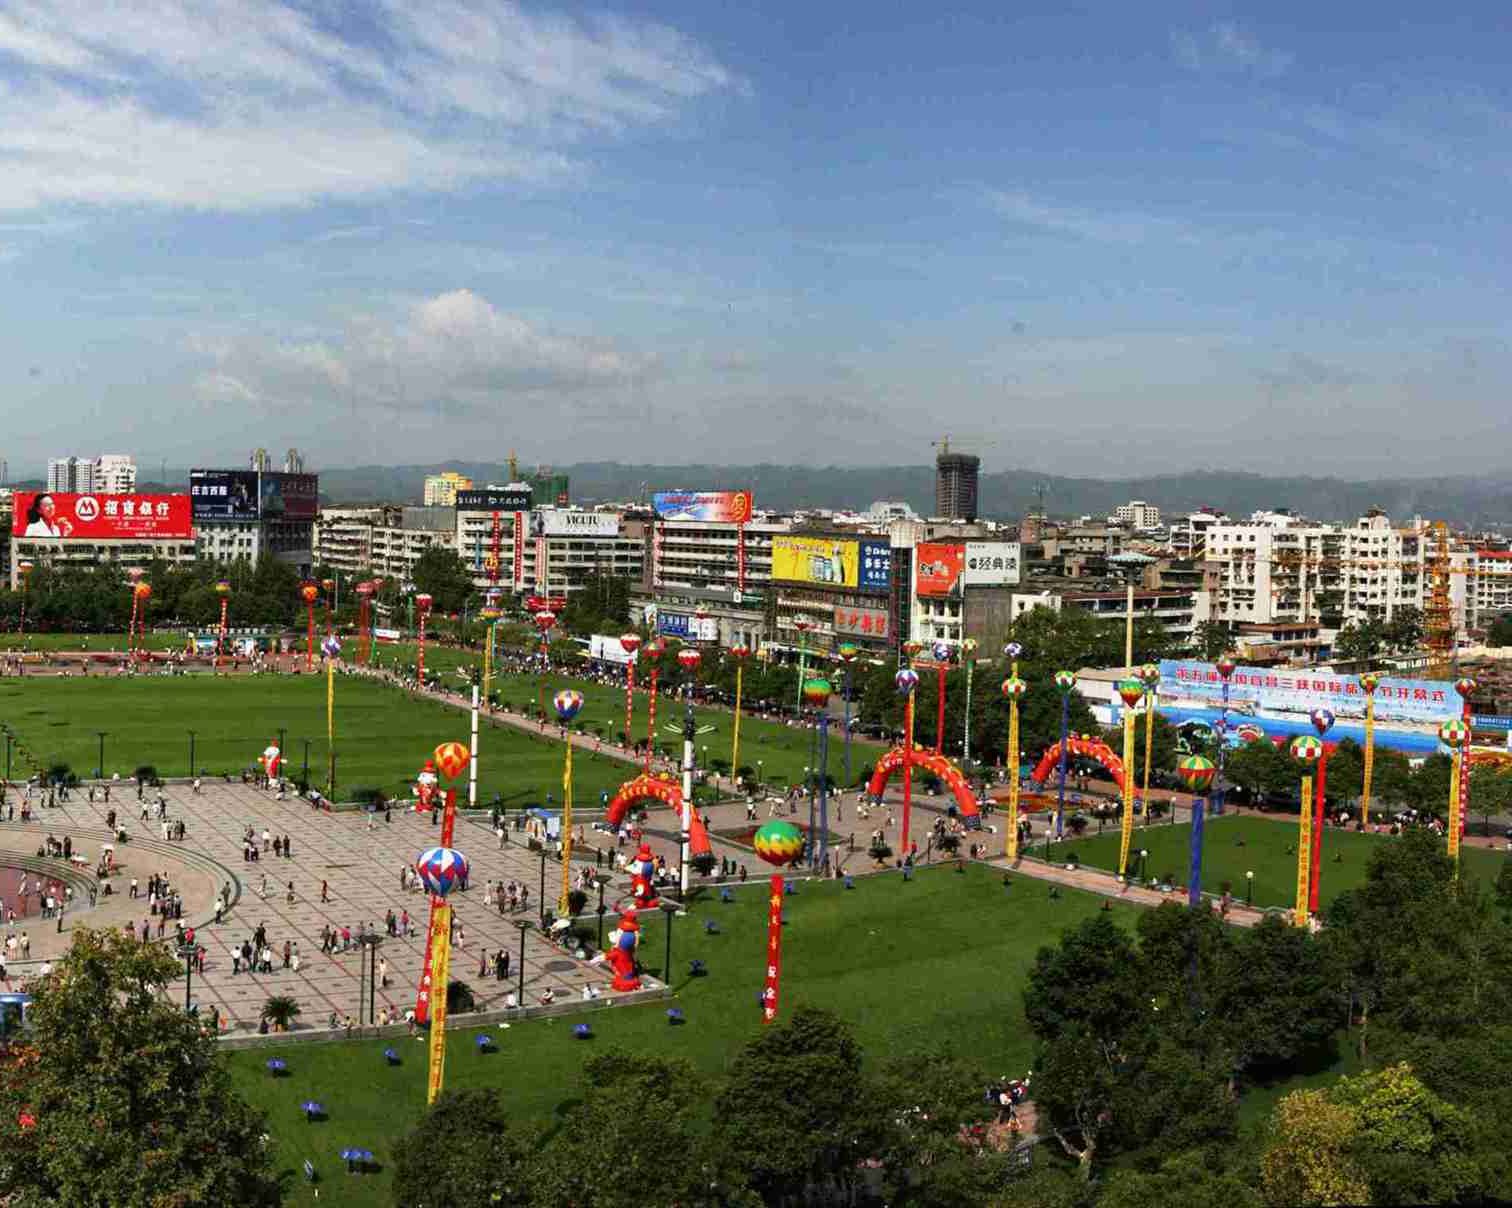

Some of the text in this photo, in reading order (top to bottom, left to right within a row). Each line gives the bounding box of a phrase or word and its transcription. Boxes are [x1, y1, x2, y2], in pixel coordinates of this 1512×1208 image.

[104, 500, 169, 515] 招商银行
[1176, 668, 1445, 701] 第五届国宜昌三峡国际旅节开幕式
